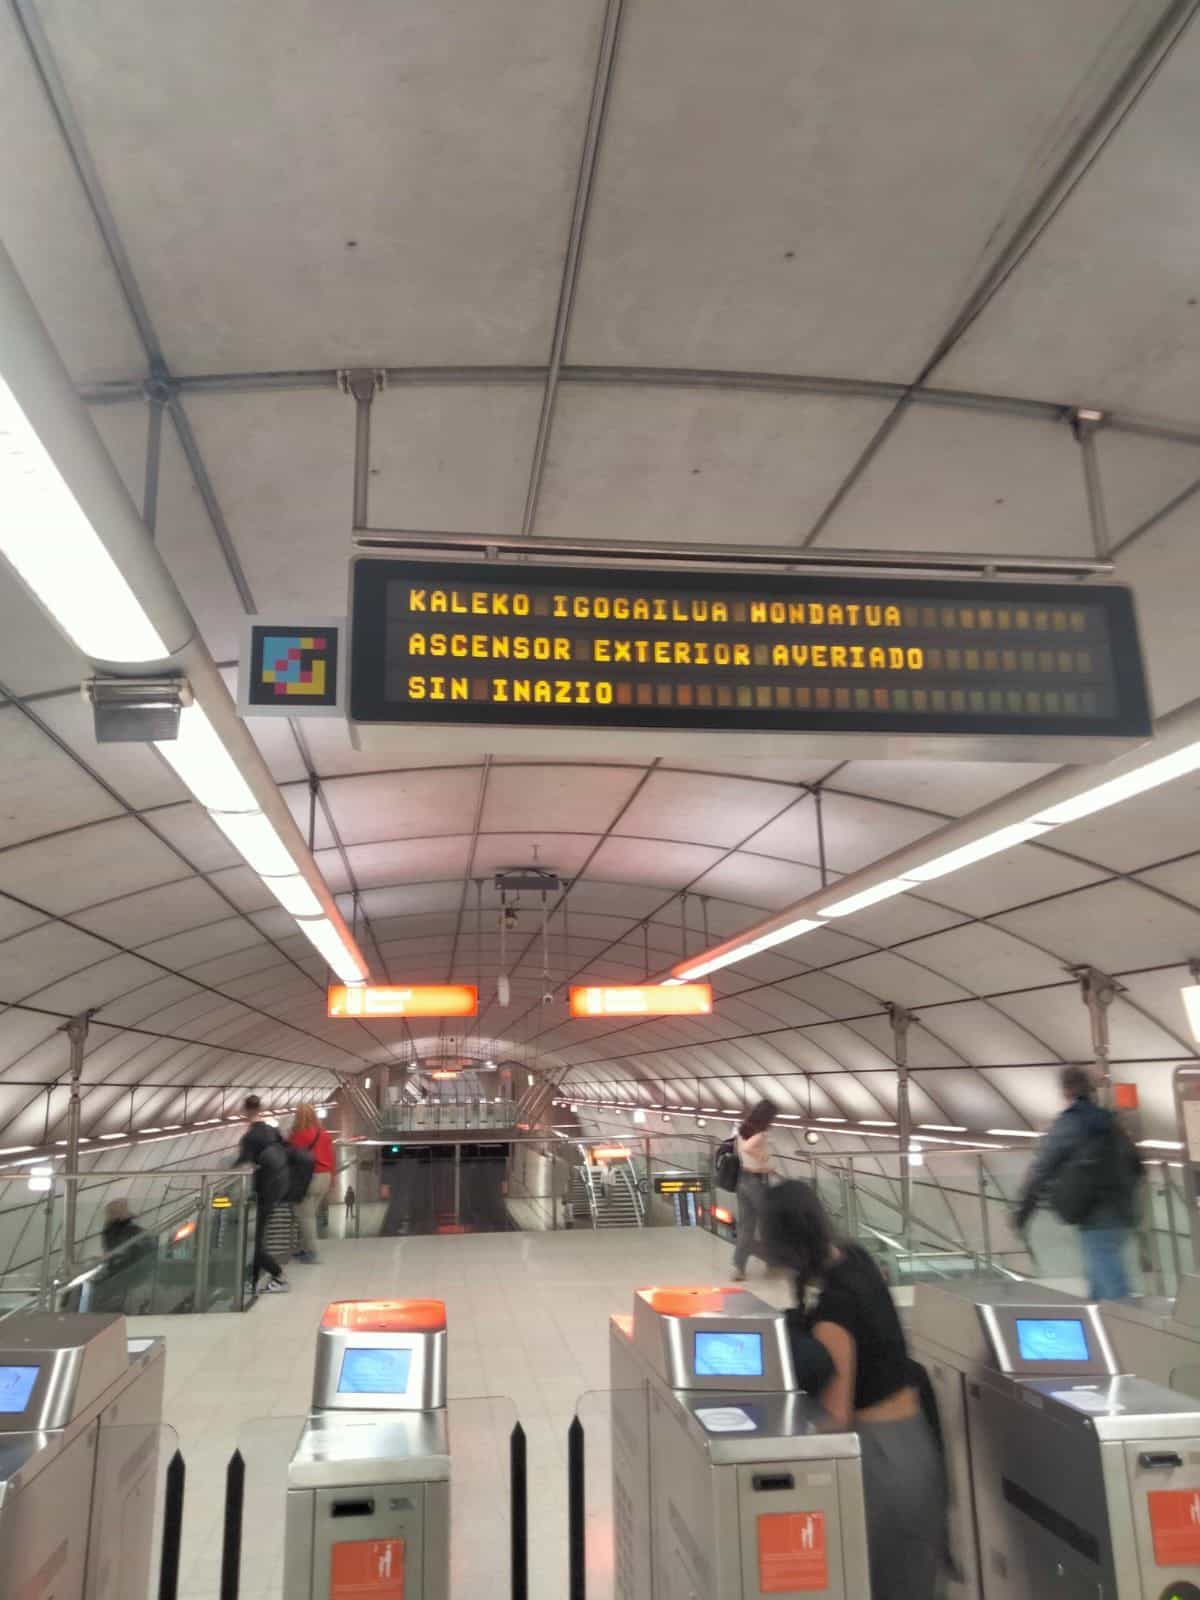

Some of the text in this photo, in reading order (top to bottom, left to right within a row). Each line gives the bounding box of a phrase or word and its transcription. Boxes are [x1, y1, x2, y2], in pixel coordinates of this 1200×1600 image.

[410, 590, 529, 615] KALEKO
[554, 596, 728, 621] IGOGAILUA
[409, 633, 923, 669] ASCENSOR EXTERIOR AVERIADO
[409, 676, 612, 704] SIN INAZIO
